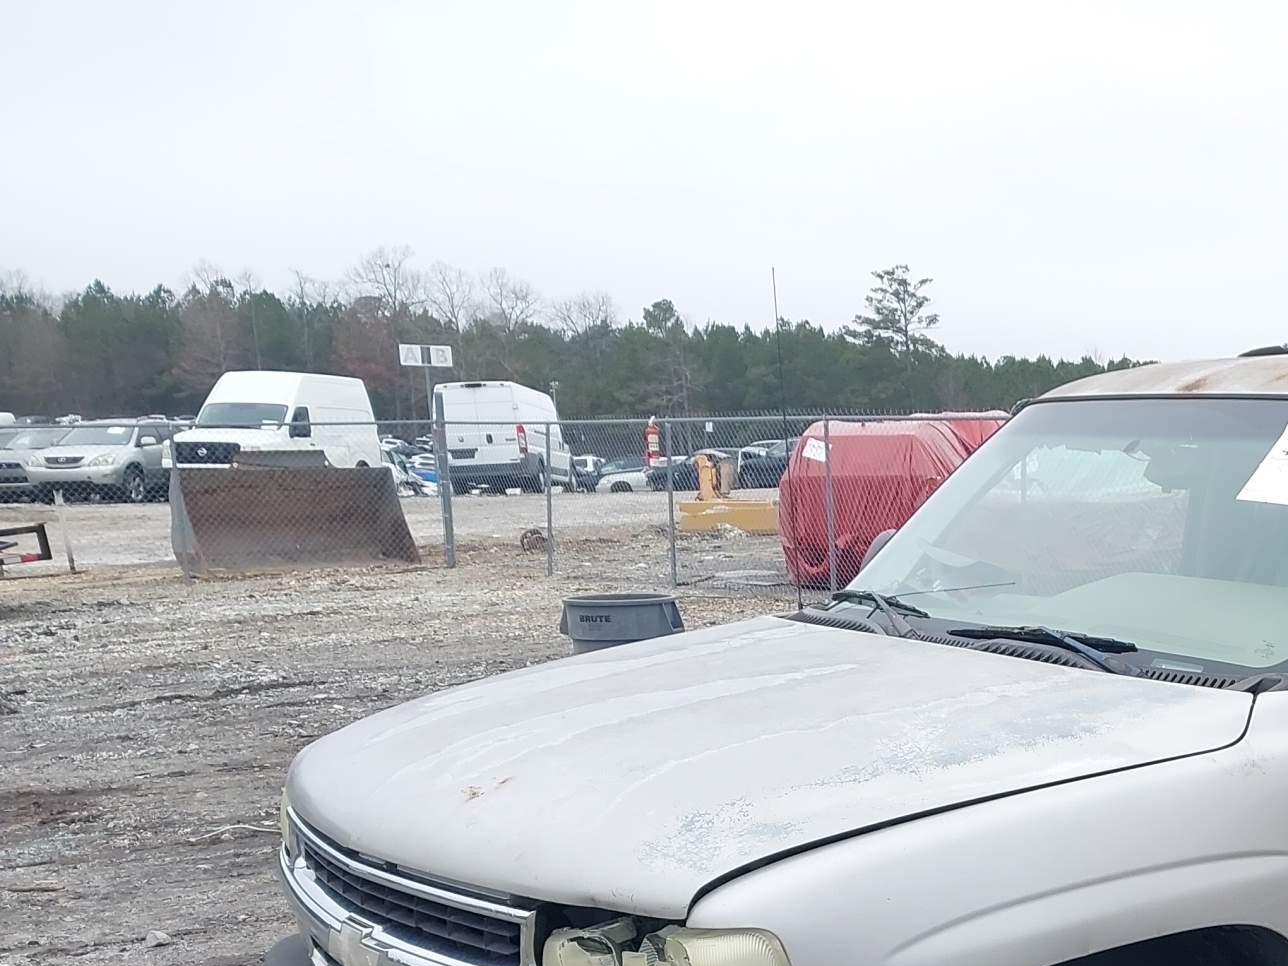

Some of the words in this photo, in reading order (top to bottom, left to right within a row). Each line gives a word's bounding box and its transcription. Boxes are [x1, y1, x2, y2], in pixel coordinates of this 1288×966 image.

[403, 346, 418, 363] A
[434, 348, 449, 364] B
[579, 615, 612, 623] BRUTE
